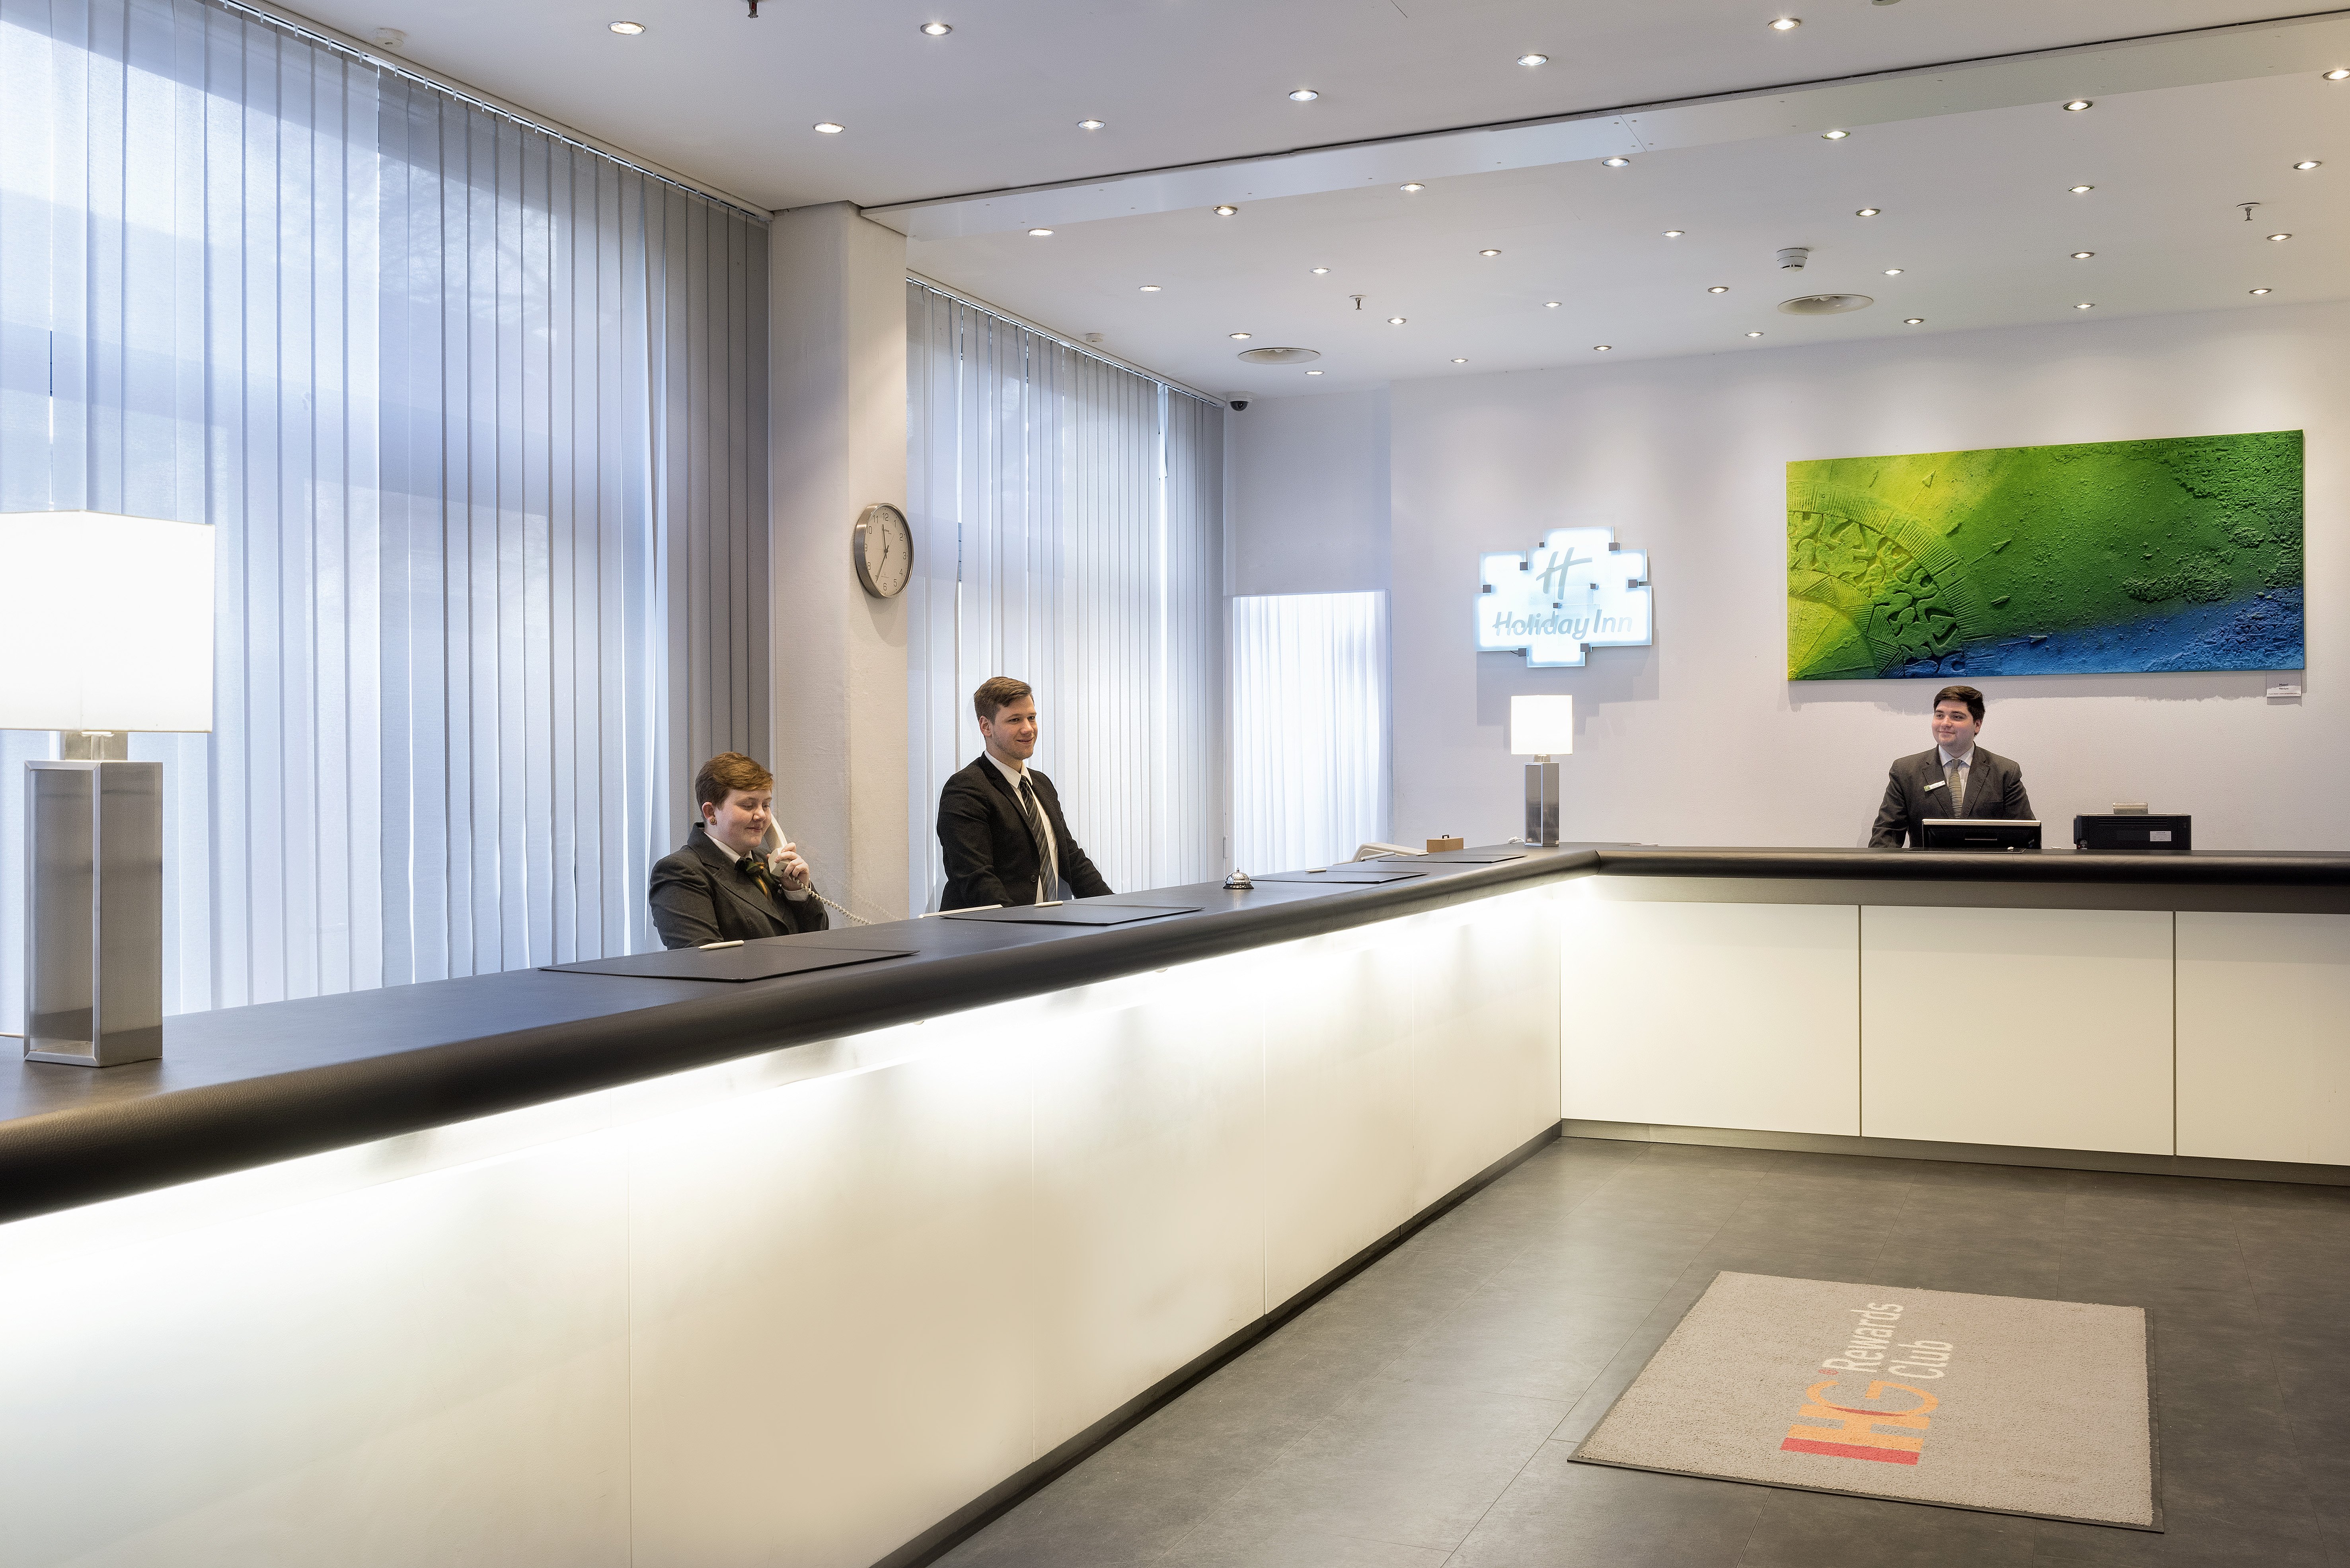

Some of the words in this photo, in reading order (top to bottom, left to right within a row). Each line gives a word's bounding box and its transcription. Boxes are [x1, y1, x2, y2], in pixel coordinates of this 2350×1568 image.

[873, 515, 878, 523] 11
[883, 512, 889, 521] 12
[867, 526, 872, 534] 10
[899, 533, 903, 541] 2
[1493, 610, 1590, 640] Holiday
[1593, 609, 1632, 633] Inn
[1822, 1302, 1904, 1373] Rewards
[1888, 1340, 1953, 1379] Club
[1780, 1380, 1939, 1466] IHG
